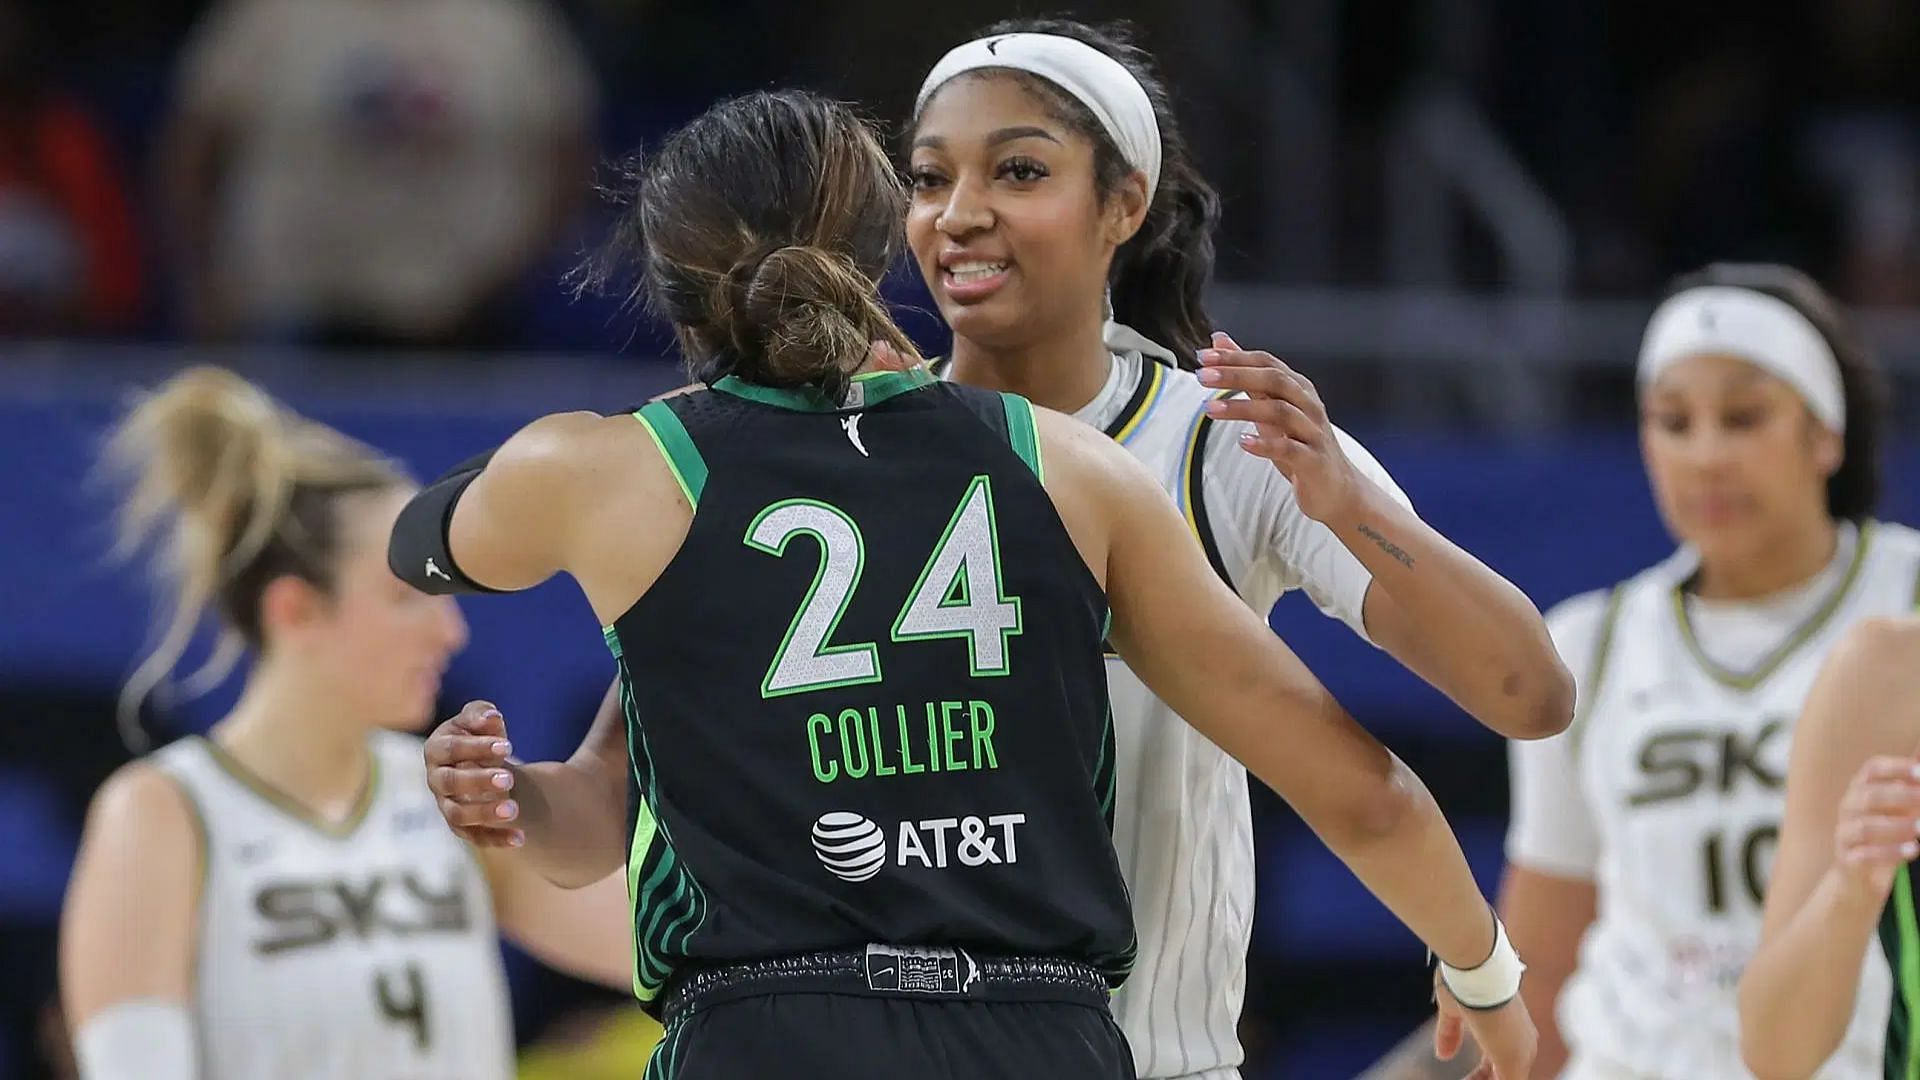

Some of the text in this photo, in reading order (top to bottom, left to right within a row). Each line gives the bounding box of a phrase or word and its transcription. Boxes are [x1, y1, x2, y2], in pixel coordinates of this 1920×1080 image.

[743, 475, 1023, 698] 24
[806, 700, 998, 783] COLLIER
[1628, 718, 1789, 805] SK
[897, 813, 1026, 868] AT&T
[251, 872, 471, 956] SKY
[374, 965, 431, 1051] 4
